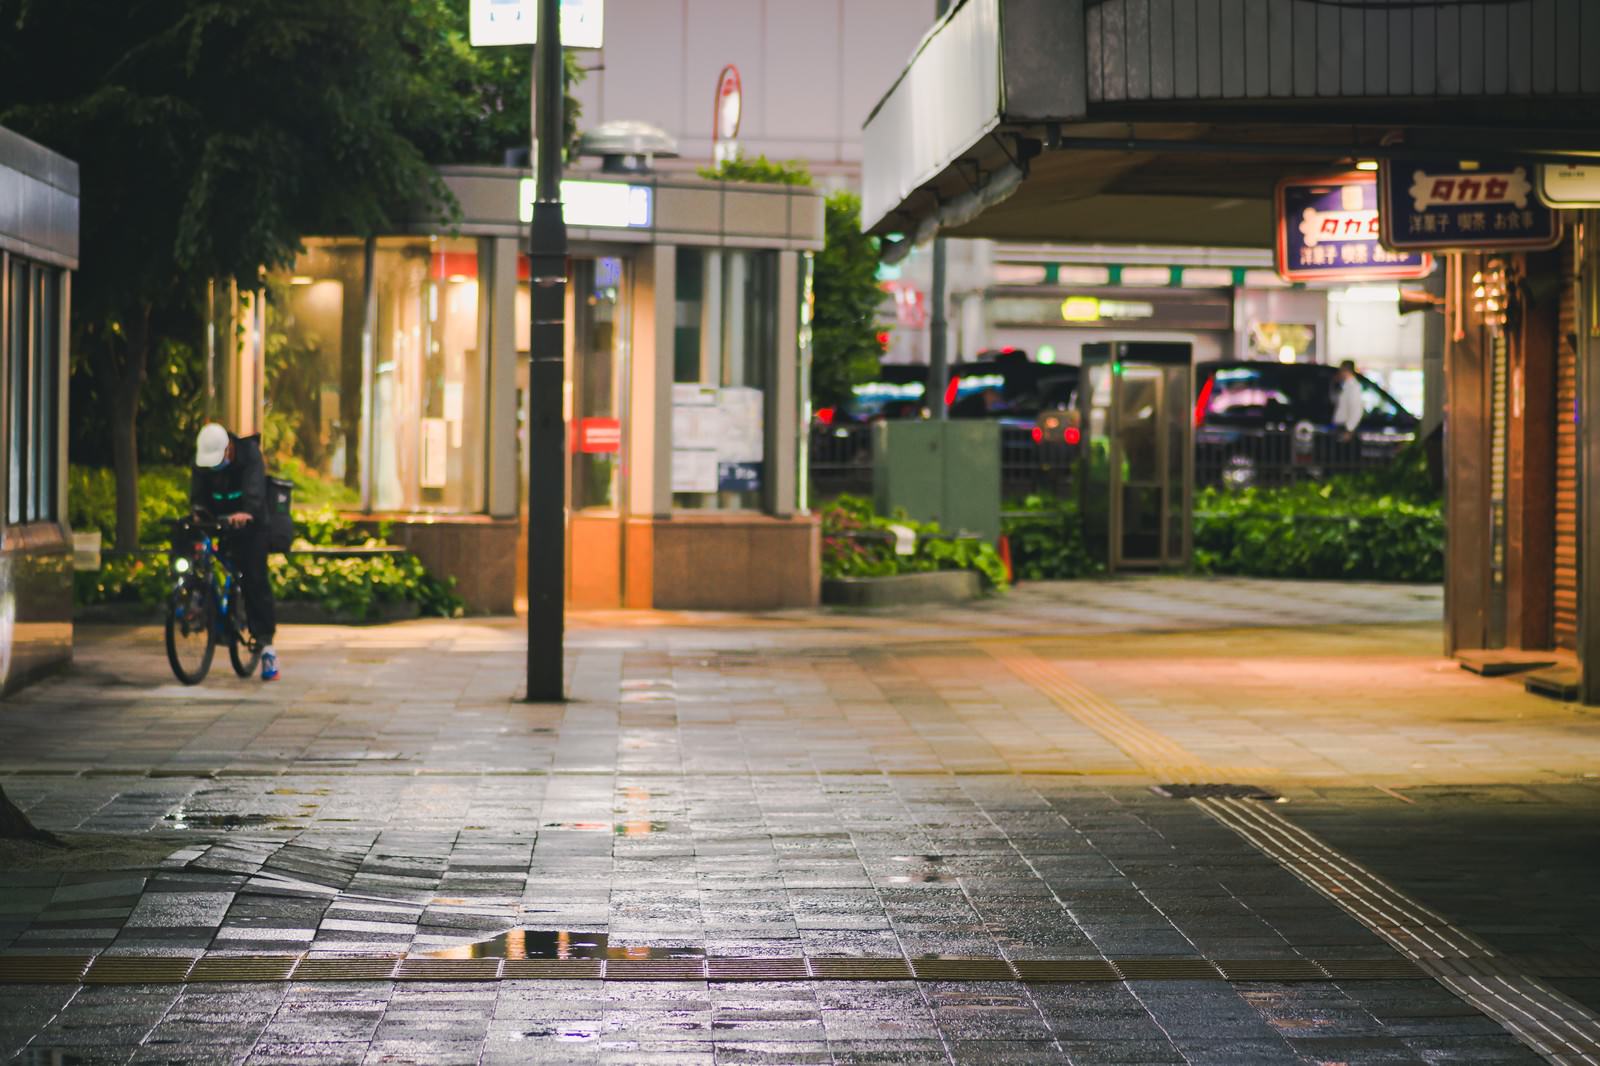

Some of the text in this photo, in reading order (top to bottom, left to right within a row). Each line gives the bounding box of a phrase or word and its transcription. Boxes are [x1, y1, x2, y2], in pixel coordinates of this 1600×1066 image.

[1430, 177, 1509, 201] タカセ
[1408, 210, 1534, 233] 洋菓子 喫茶 お食事
